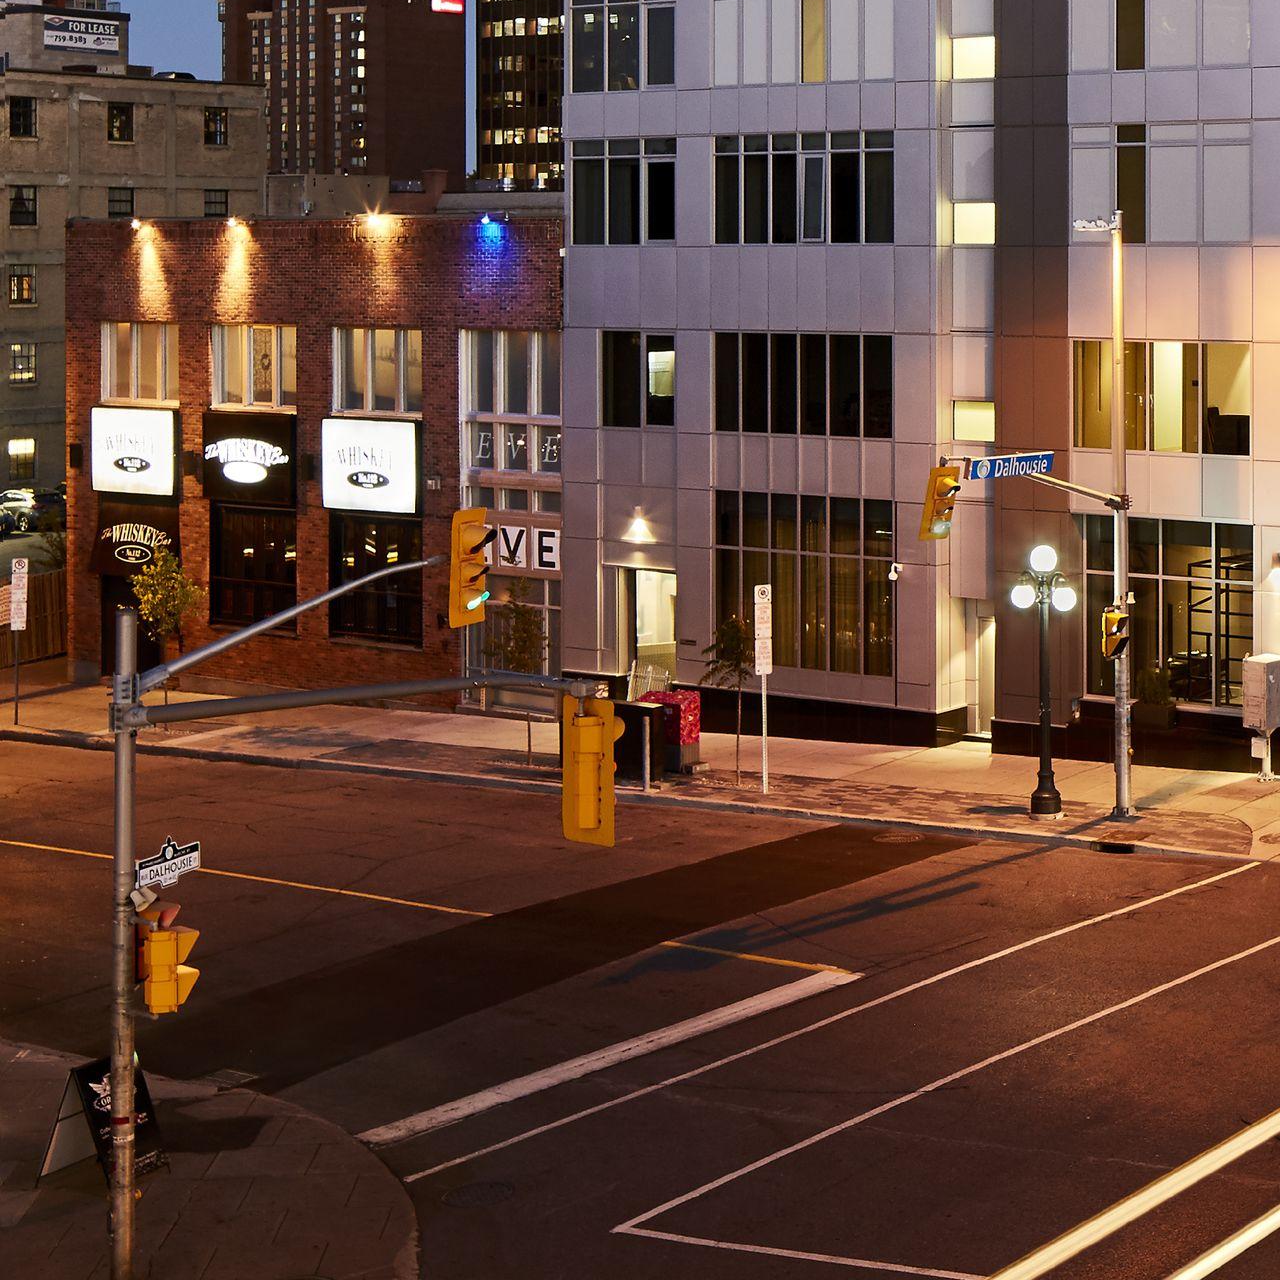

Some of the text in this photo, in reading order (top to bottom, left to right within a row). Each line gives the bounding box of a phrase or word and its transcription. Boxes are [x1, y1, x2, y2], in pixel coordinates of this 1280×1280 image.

[68, 21, 115, 35] FOR LEASE
[476, 432, 559, 462] EVE
[994, 454, 1048, 478] Dalhousie
[112, 523, 160, 547] WHISKEY
[156, 531, 172, 545] Bar
[485, 527, 556, 568] VE
[149, 856, 192, 880] DALHOUSIE
